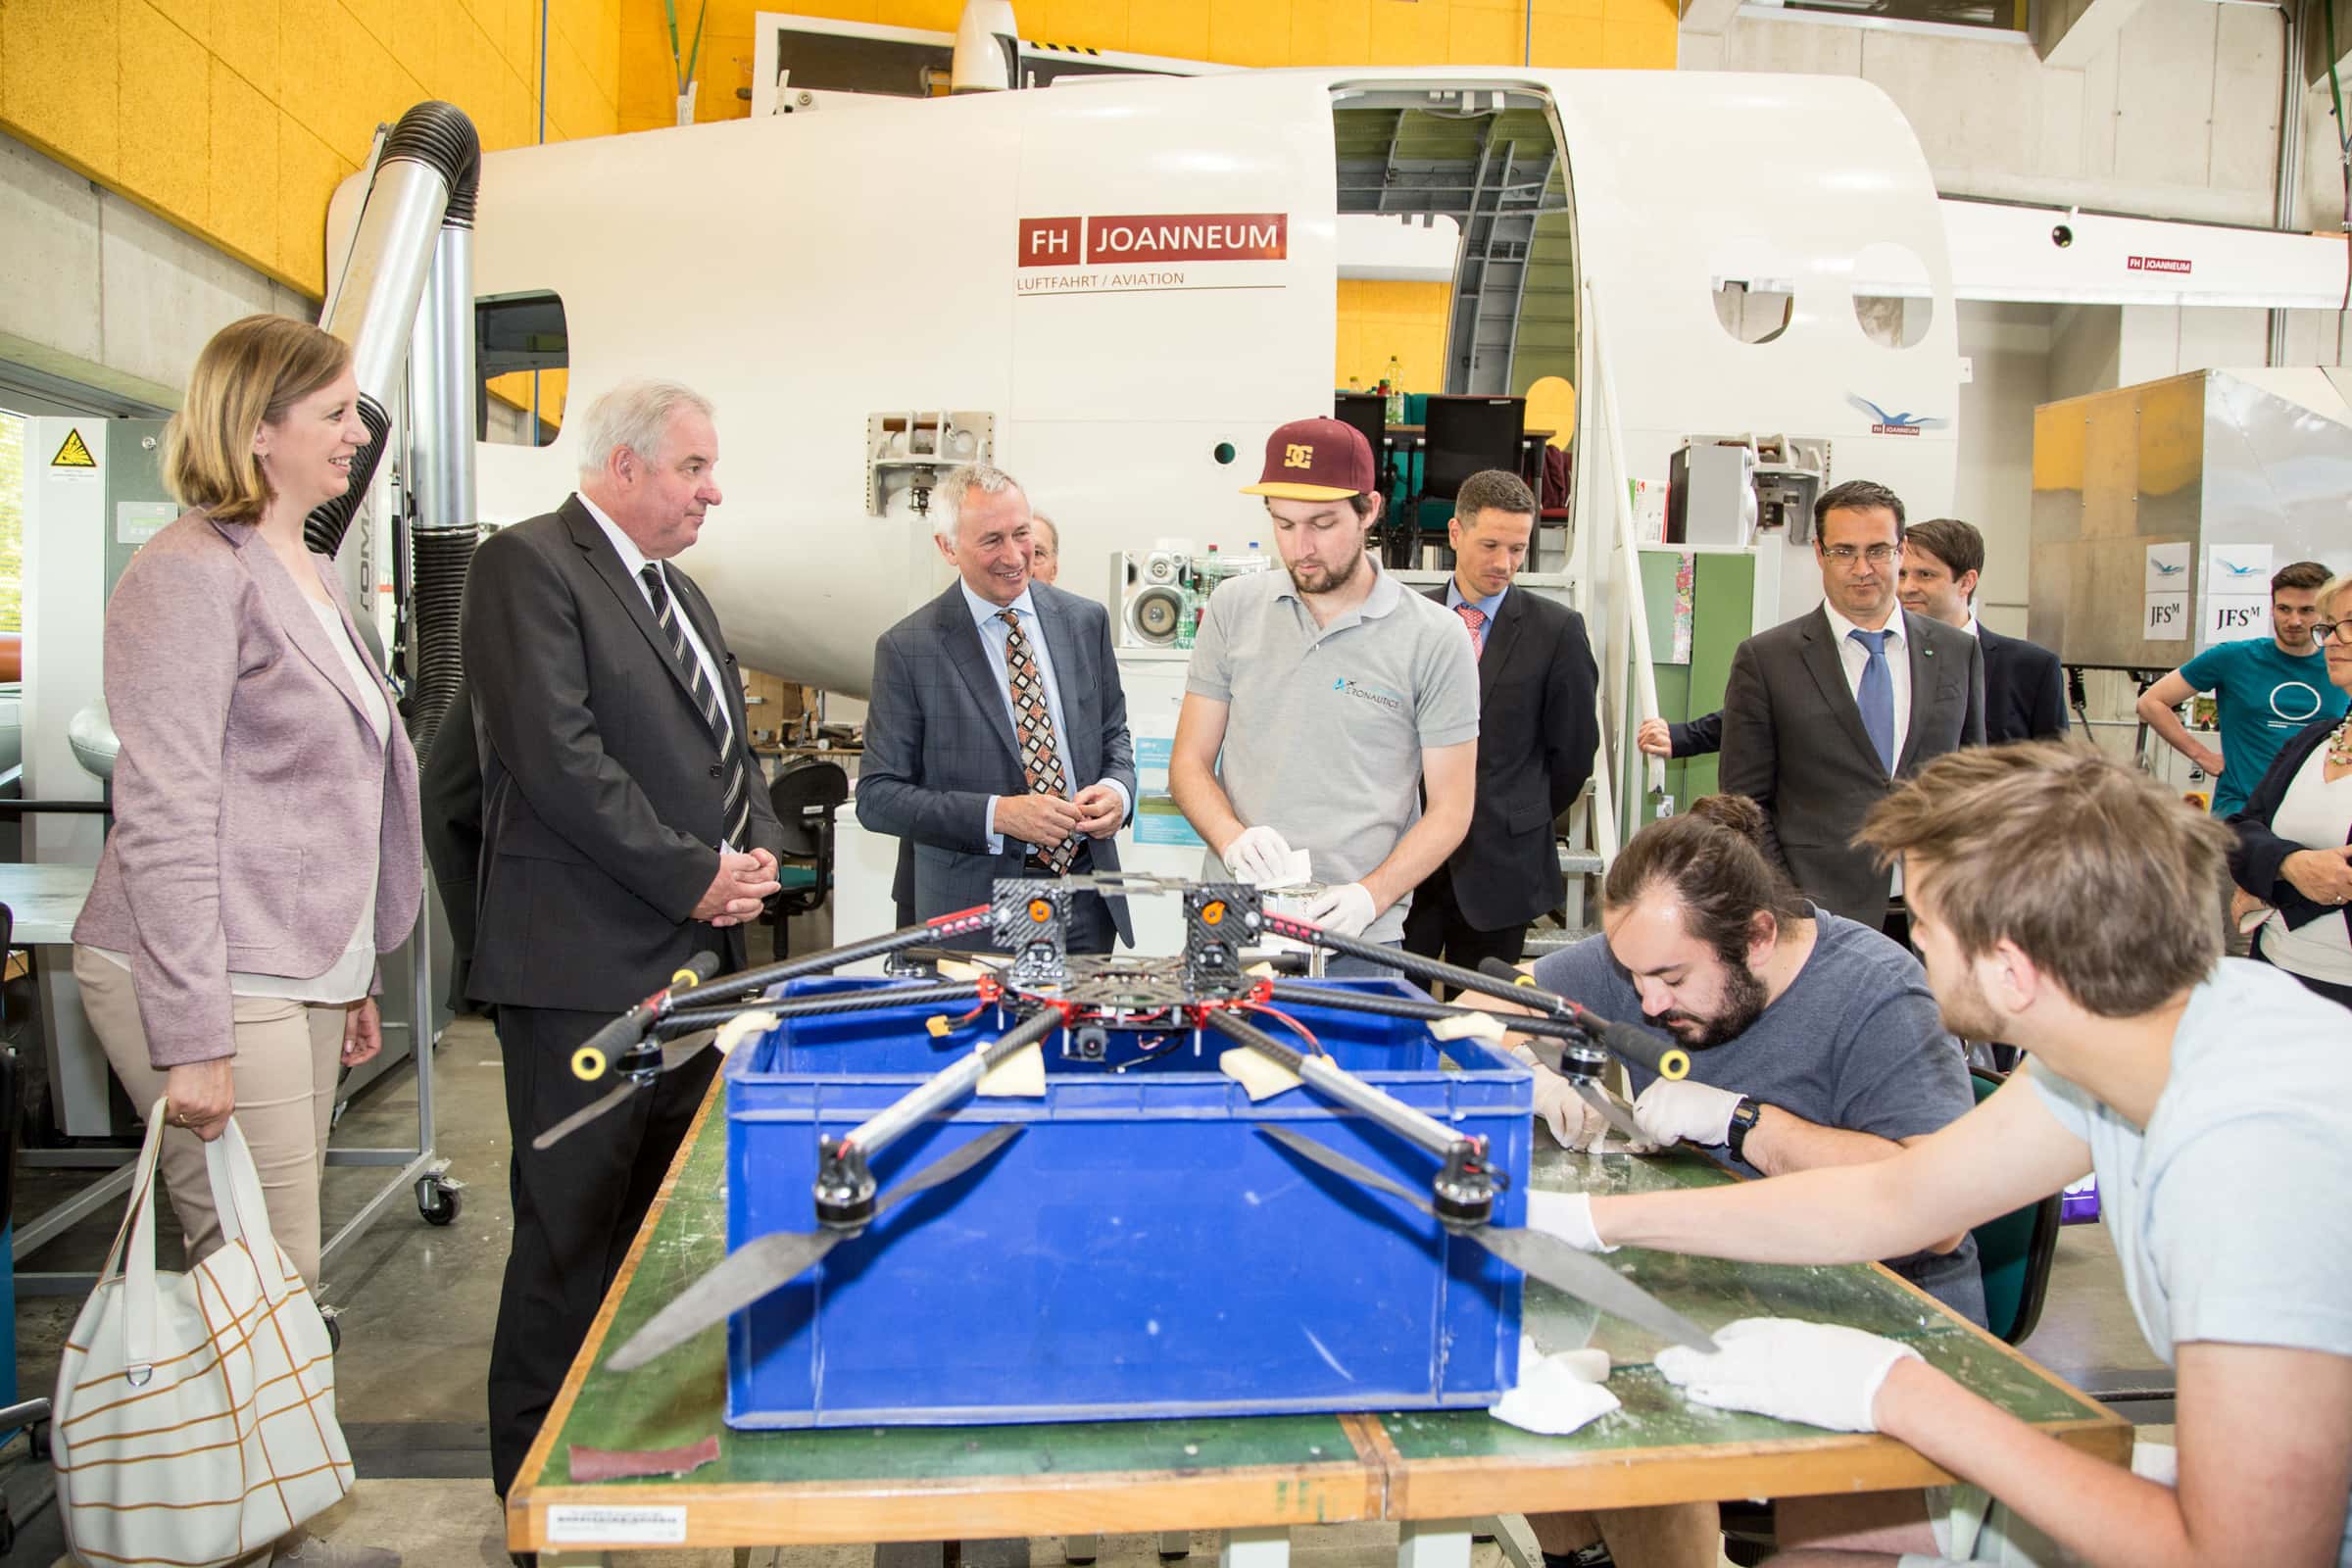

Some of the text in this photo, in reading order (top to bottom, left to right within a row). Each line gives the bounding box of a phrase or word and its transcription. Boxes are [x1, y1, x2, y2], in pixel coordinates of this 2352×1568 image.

[1031, 224, 1278, 255] FH JOANNEUM
[2146, 259, 2190, 271] JOANNEUM
[1017, 274, 1098, 291] LUFTFAHRT
[1111, 272, 1185, 286] AVIATION
